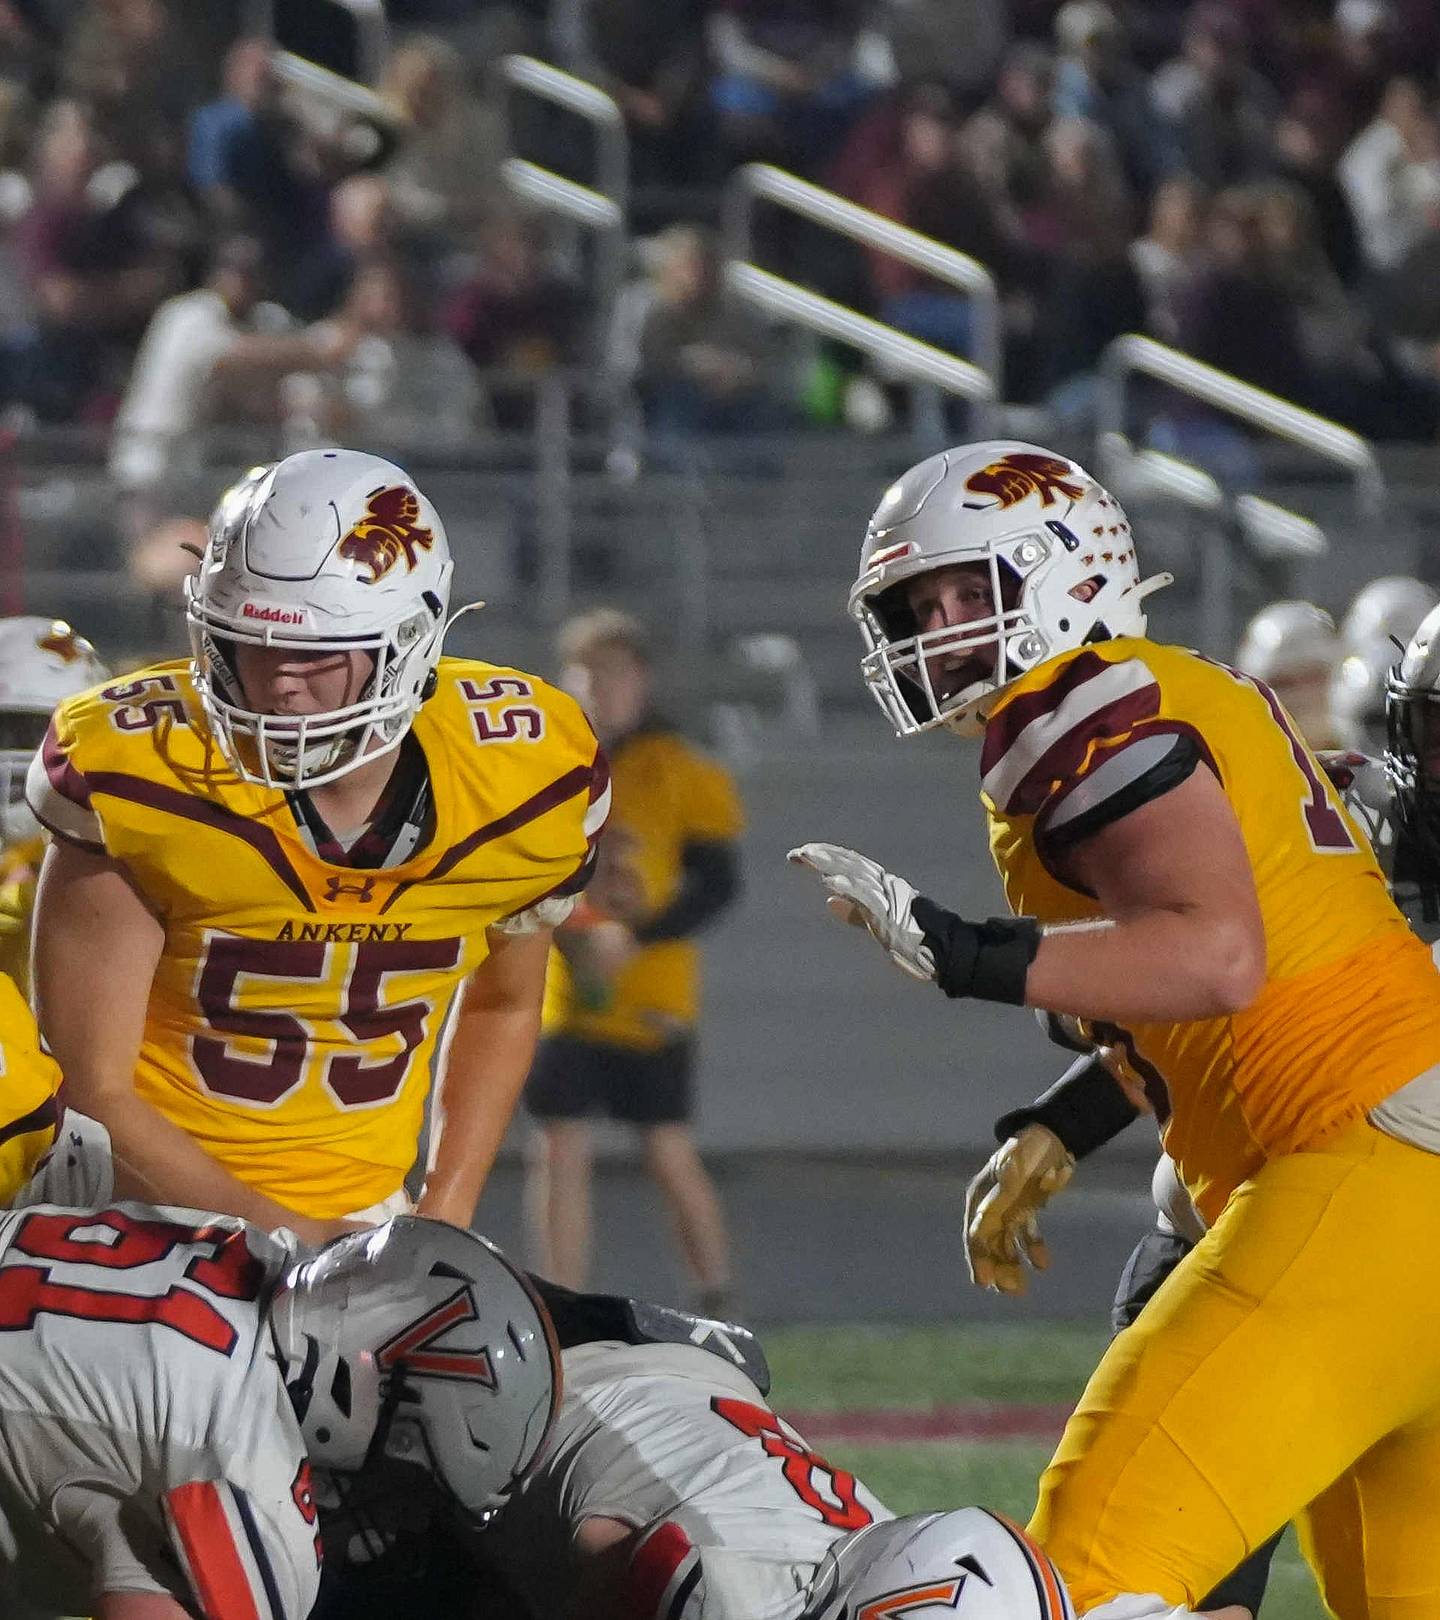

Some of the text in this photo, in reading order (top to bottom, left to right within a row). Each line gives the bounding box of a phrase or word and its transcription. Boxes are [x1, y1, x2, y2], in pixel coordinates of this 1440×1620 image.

[242, 602, 304, 625] Riddell
[100, 673, 190, 736] 55
[457, 676, 545, 745] 55
[276, 920, 412, 942] ANKENY
[188, 928, 465, 1110] 55
